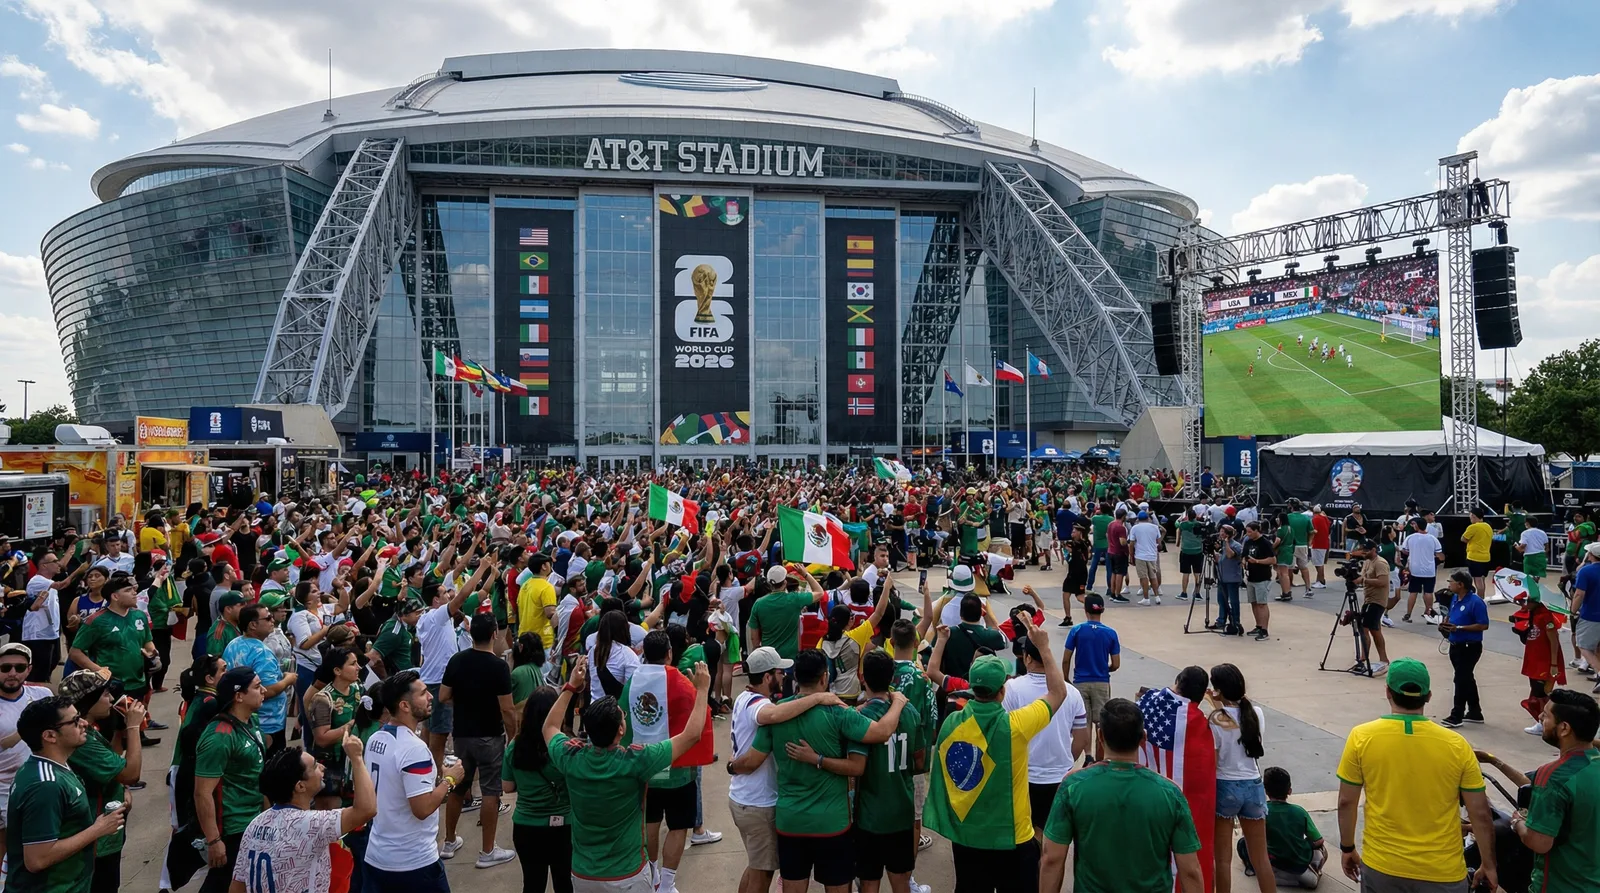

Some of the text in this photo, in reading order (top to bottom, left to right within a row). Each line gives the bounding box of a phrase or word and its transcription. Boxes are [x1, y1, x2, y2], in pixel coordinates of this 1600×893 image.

[583, 137, 825, 177] AT&T STADIUM
[1227, 299, 1241, 307] USA
[690, 327, 719, 338] FIFA
[675, 345, 711, 353] WORLD
[675, 354, 735, 368] 2026
[884, 732, 908, 772] 11
[248, 850, 276, 893] 10
